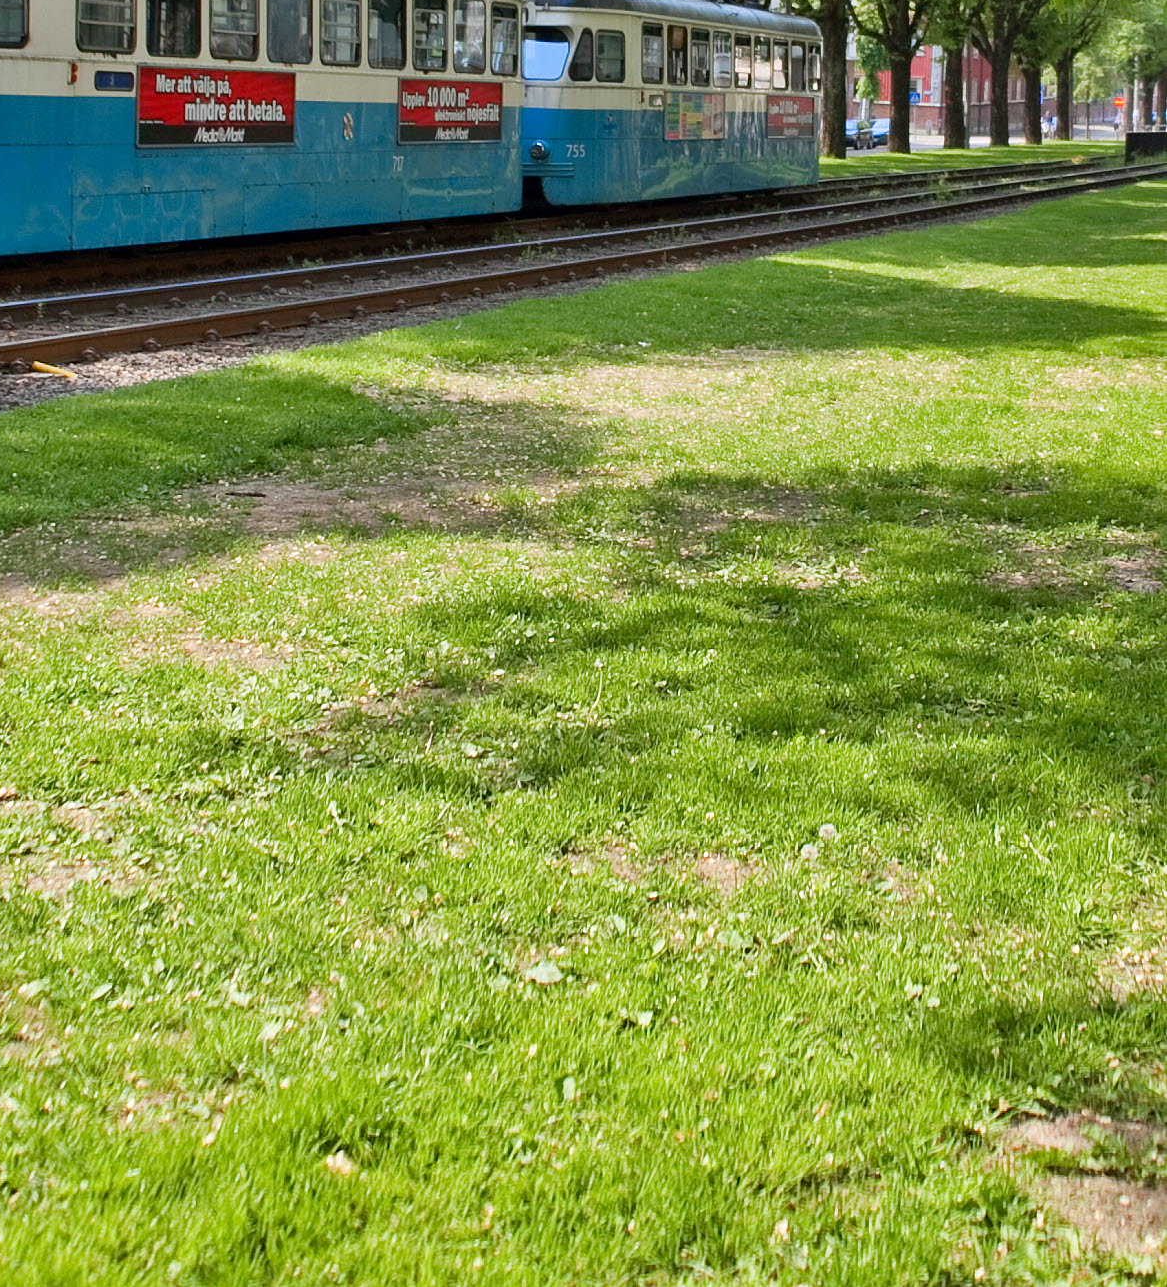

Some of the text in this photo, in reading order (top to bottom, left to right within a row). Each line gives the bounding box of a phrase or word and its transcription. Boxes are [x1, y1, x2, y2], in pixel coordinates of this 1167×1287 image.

[155, 73, 232, 98] Mer att välja på,
[184, 98, 286, 122] mindre att betala.
[402, 91, 426, 110] Upplev
[466, 103, 500, 125] nöjesfält
[565, 144, 586, 158] 755
